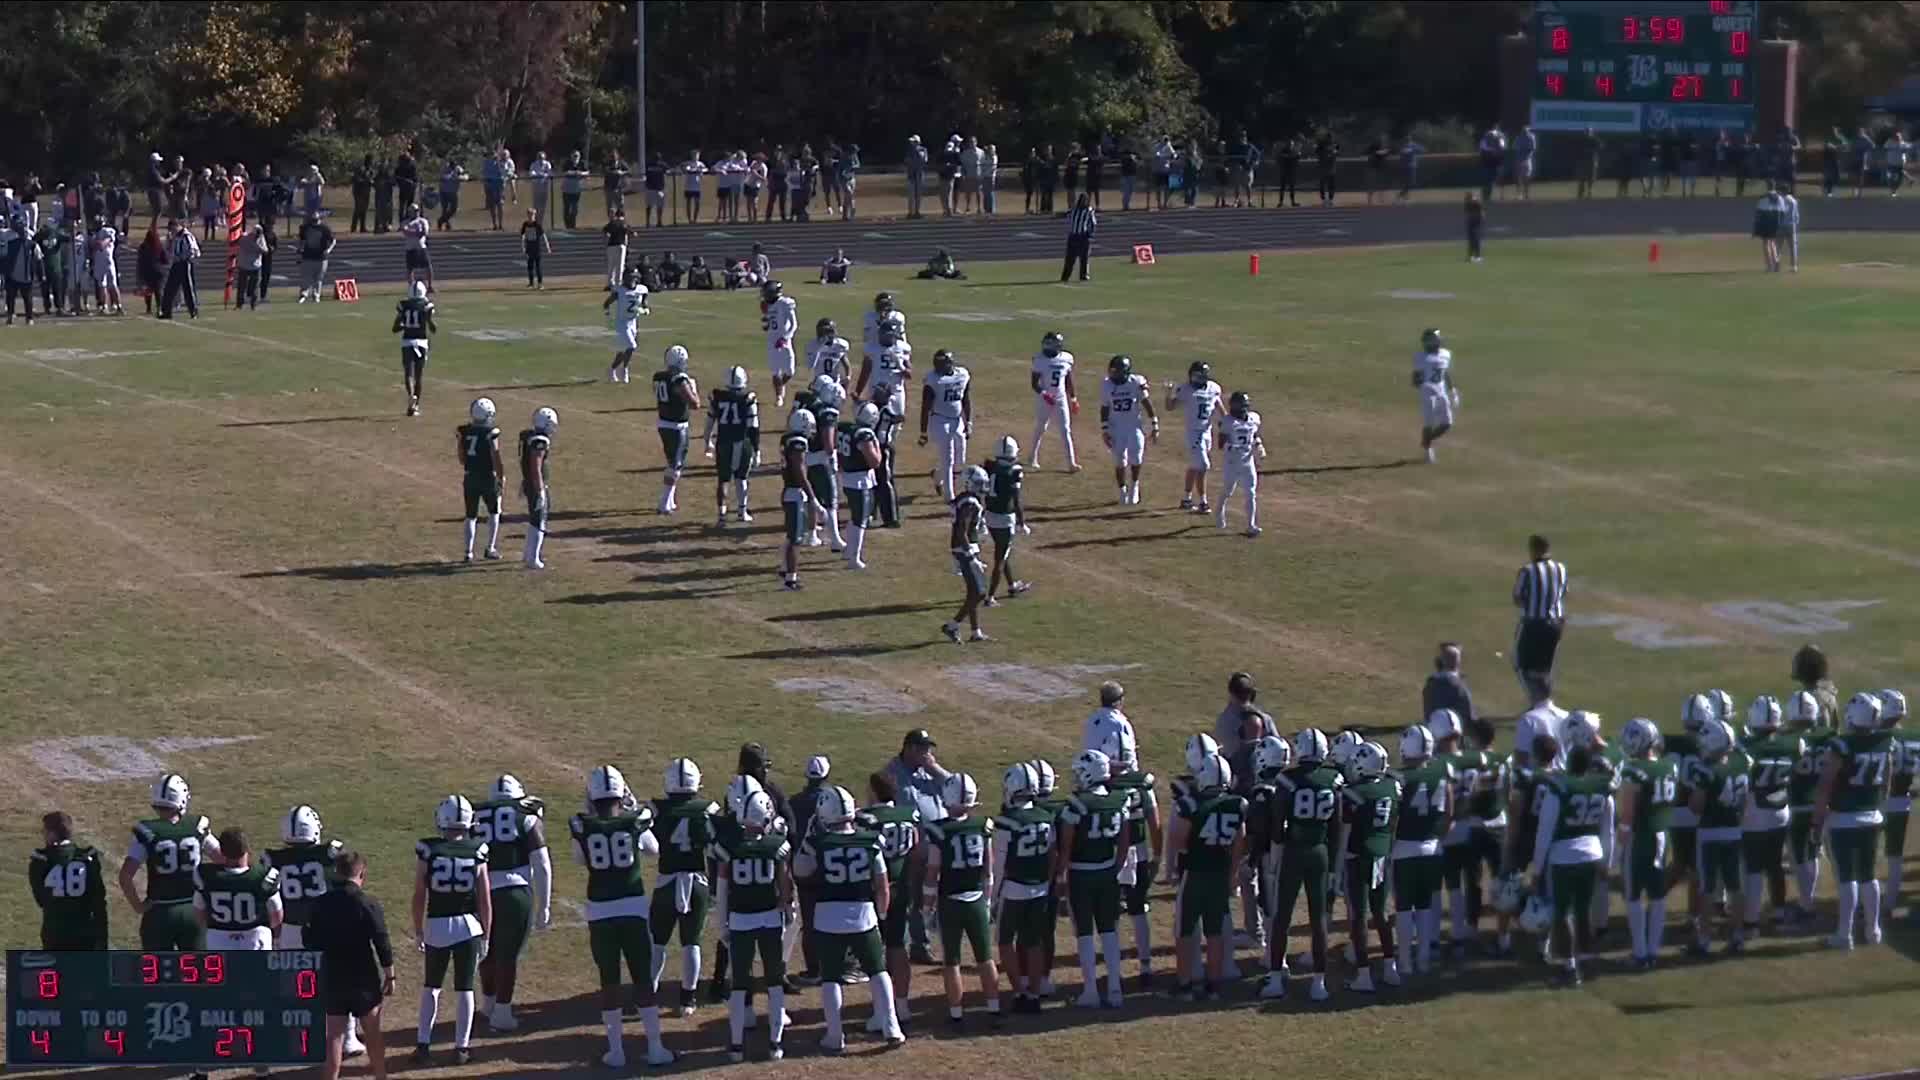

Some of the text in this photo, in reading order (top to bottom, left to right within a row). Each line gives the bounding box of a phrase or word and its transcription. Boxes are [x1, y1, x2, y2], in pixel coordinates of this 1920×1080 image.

[1622, 16, 1684, 42] 3:59
[1731, 31, 1748, 55] 0
[1546, 74, 1563, 96] 4
[1596, 75, 1614, 98] 4
[1672, 75, 1702, 98] 27
[1138, 247, 1151, 263] G
[404, 311, 420, 329] 11
[1051, 371, 1061, 388] 5
[720, 402, 741, 424] 71
[465, 434, 477, 456] 7
[1849, 752, 1887, 785] 77
[1294, 787, 1335, 820] 82
[1410, 778, 1447, 816] 44
[1565, 793, 1605, 826] 32
[473, 806, 519, 843] 58
[671, 817, 693, 851] 4
[1200, 812, 1240, 846] 45
[156, 837, 201, 874] 33
[587, 831, 635, 869] 88
[824, 847, 872, 884] 52
[951, 833, 985, 868] 19
[44, 861, 88, 897] 48
[280, 861, 328, 899] 63
[431, 856, 475, 893] 25
[732, 858, 775, 885] 80
[209, 892, 257, 924] 50
